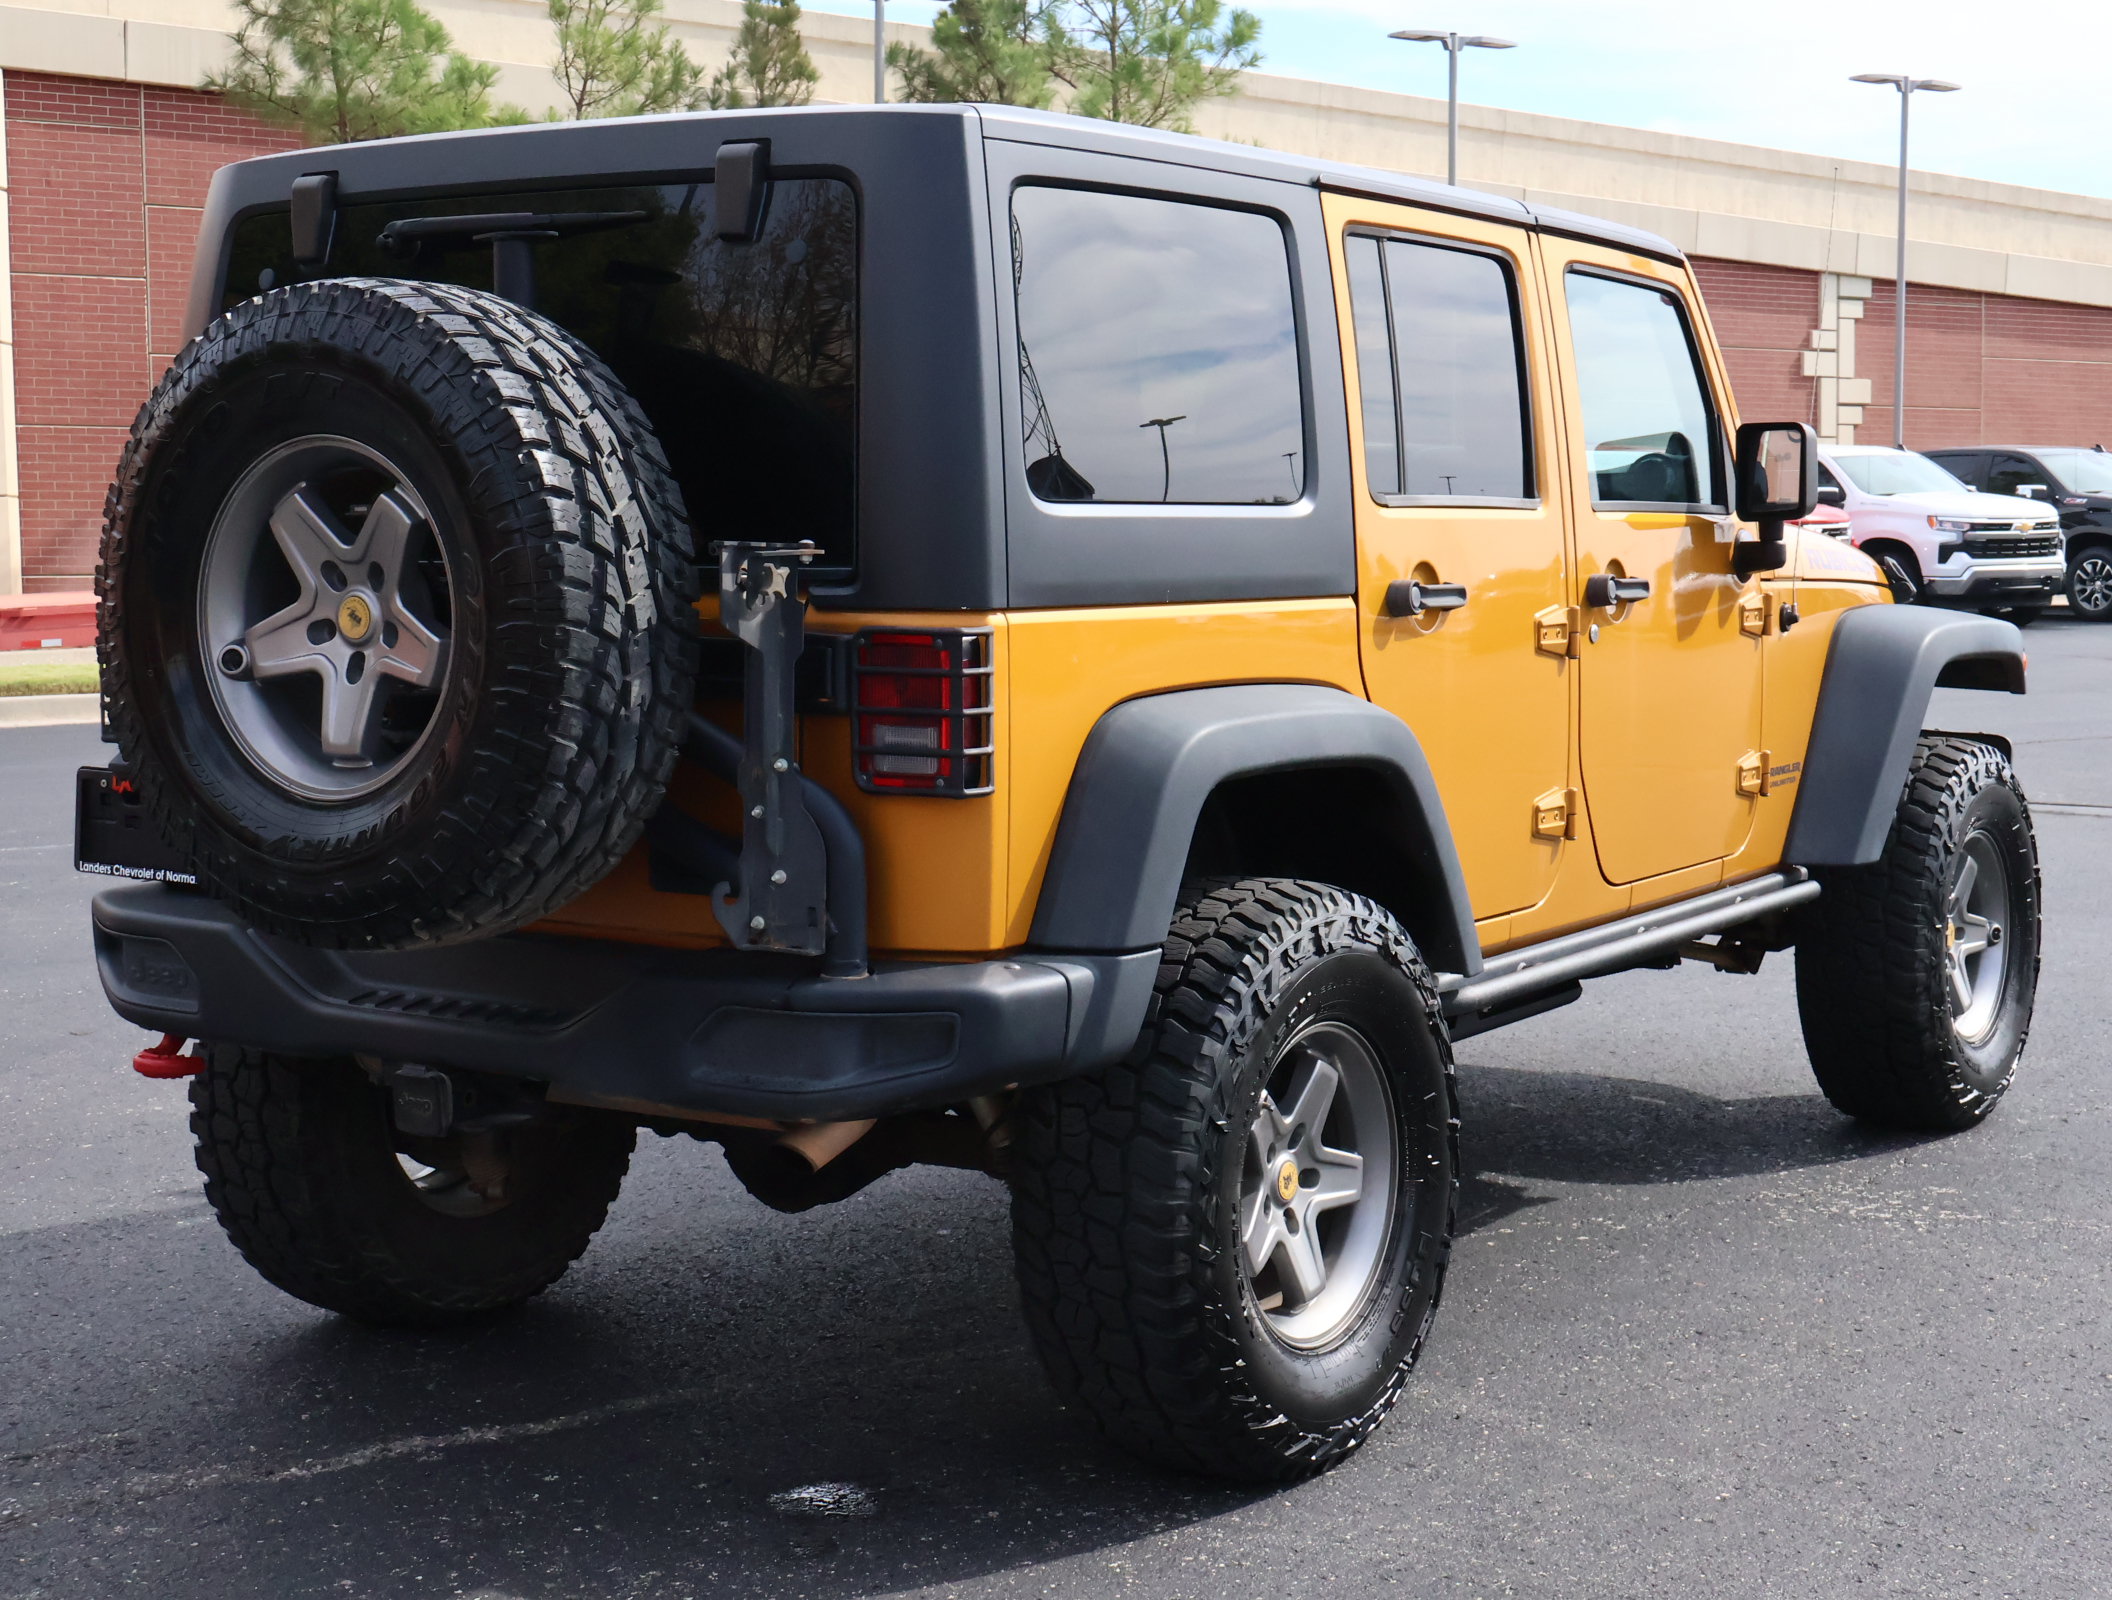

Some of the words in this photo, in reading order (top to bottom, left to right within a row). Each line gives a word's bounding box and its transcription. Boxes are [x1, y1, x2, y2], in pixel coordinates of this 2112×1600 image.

[79, 860, 112, 875] Landers
[112, 864, 154, 880] Chevrolet
[155, 869, 165, 881] of
[166, 870, 198, 885] Norma
